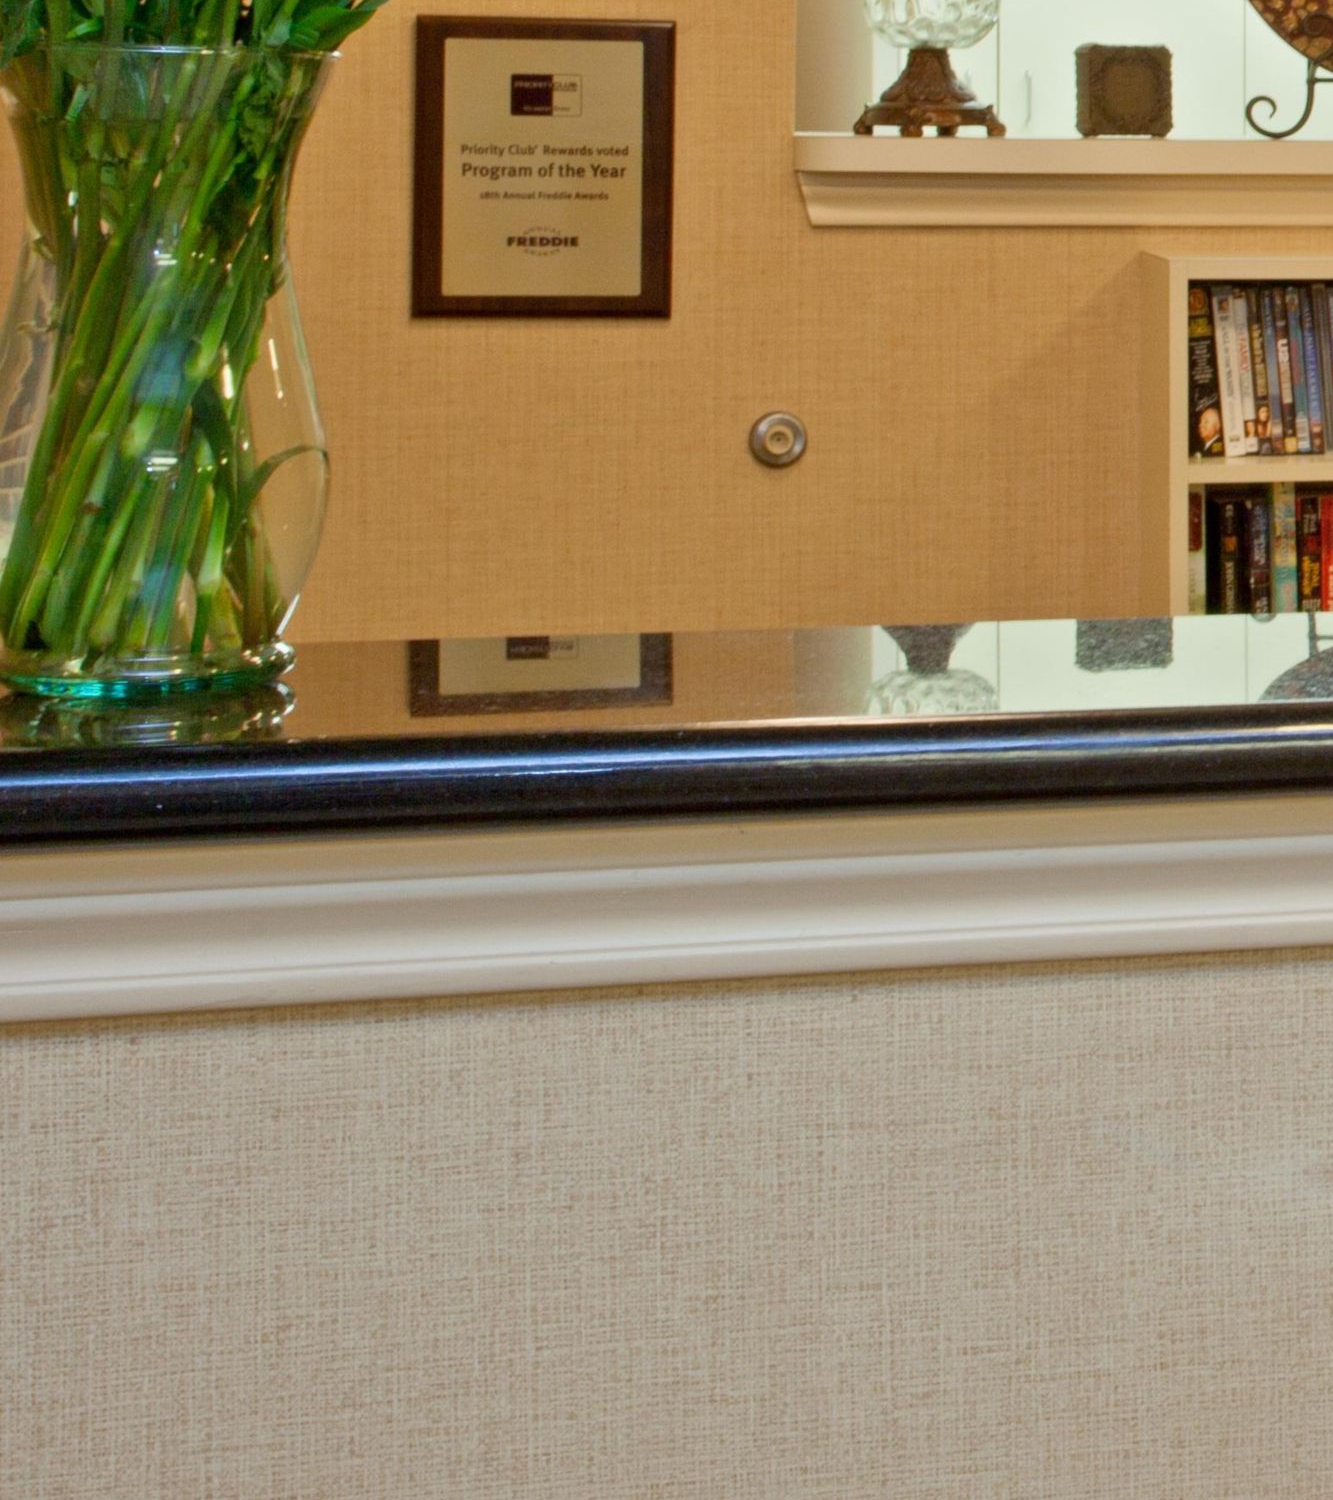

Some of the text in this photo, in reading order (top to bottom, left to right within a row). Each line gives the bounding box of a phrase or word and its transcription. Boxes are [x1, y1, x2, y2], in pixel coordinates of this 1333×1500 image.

[460, 145, 505, 157] Priority
[543, 145, 593, 155] Rewards
[597, 146, 629, 155] voted
[462, 163, 627, 180] Program of the Year
[539, 191, 572, 199] Freddie
[575, 192, 609, 200] Awards
[507, 236, 578, 246] FREDDIE
